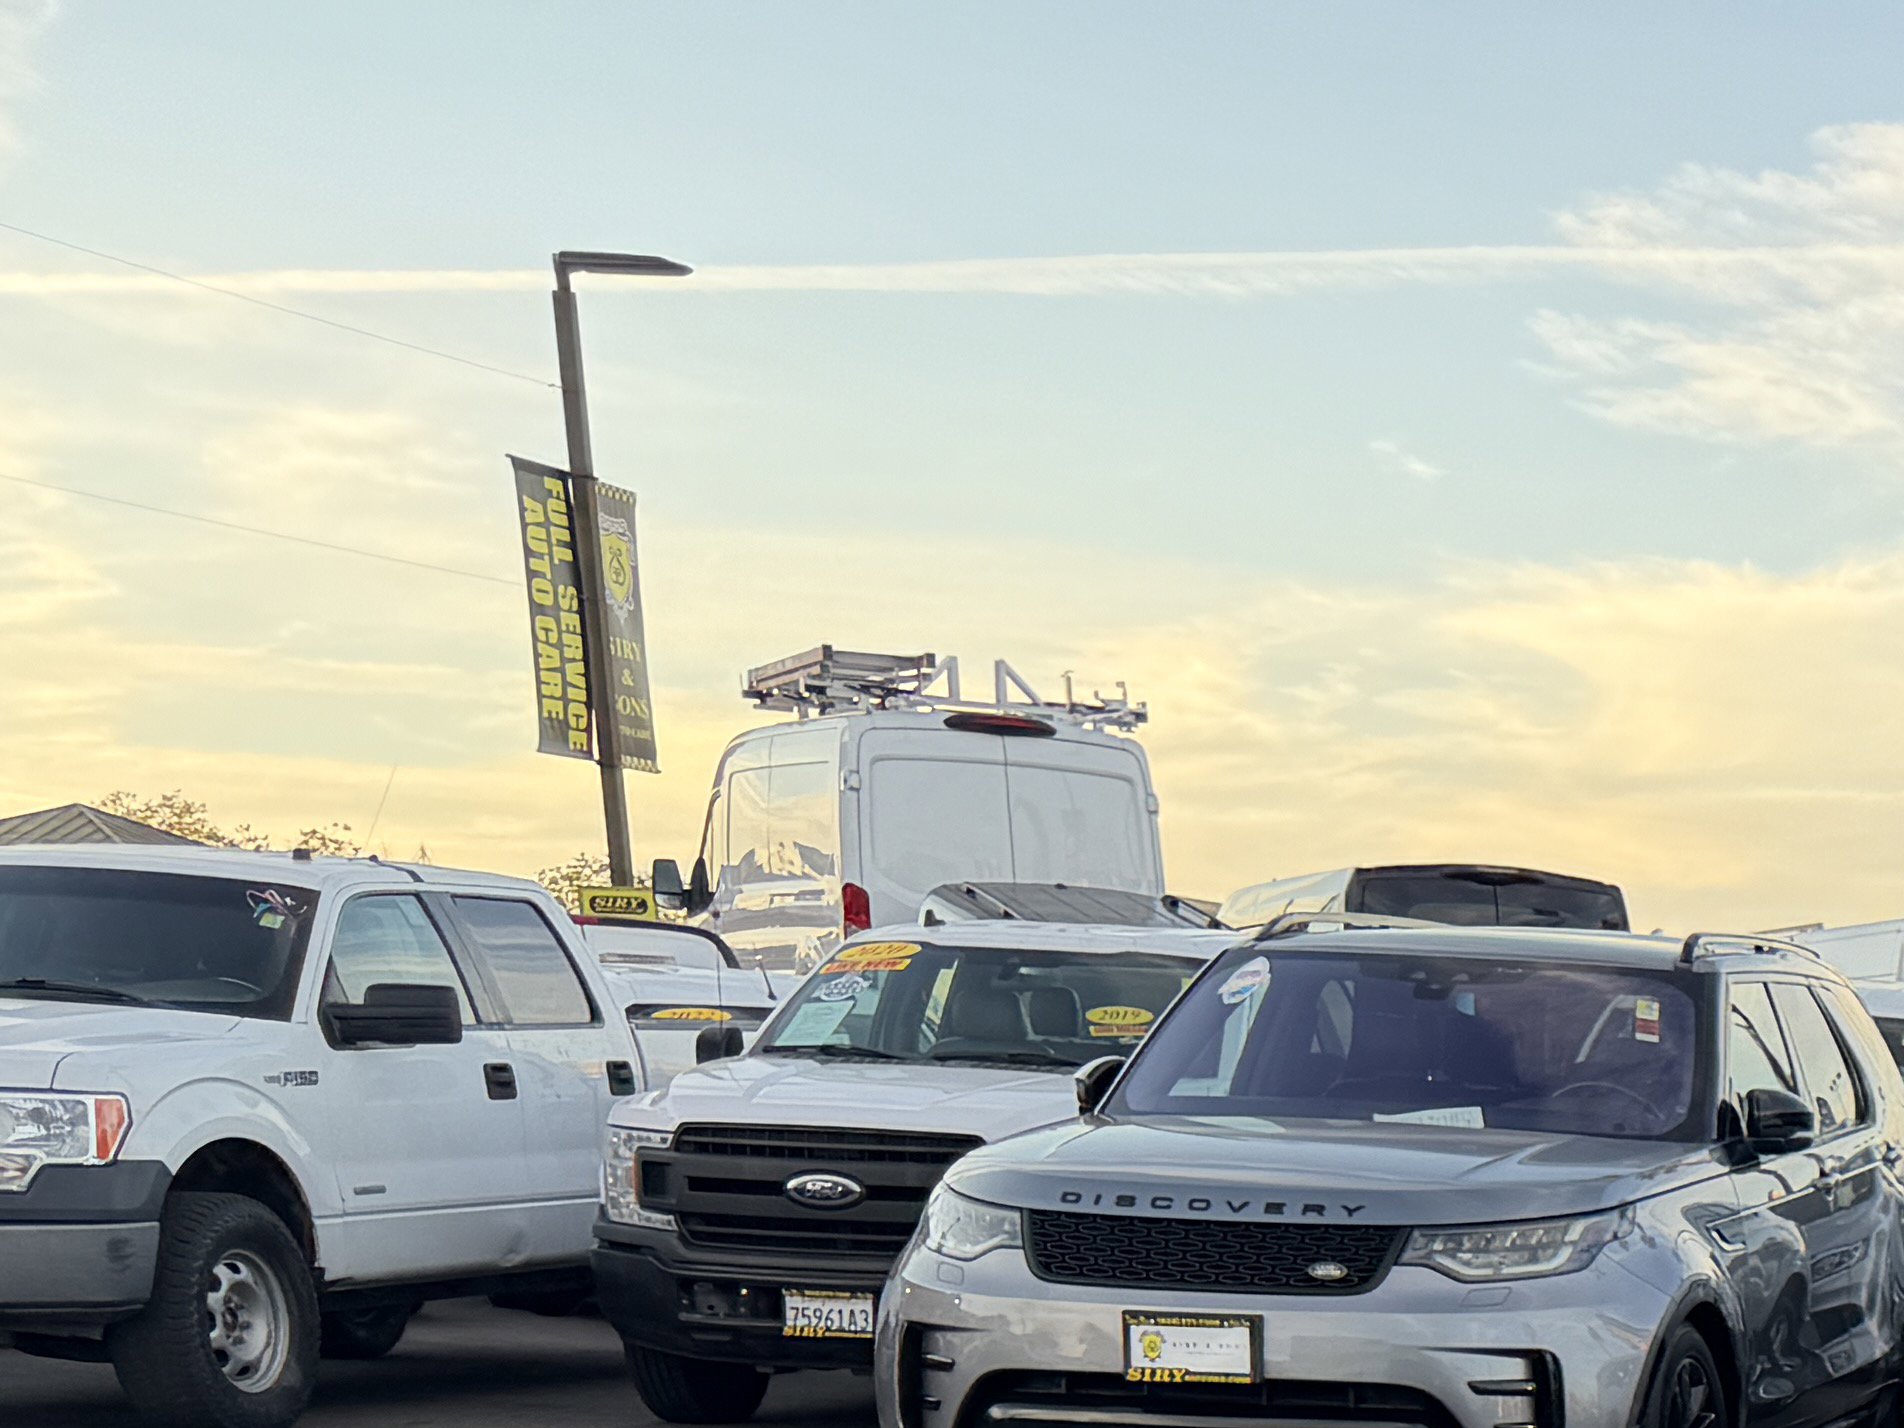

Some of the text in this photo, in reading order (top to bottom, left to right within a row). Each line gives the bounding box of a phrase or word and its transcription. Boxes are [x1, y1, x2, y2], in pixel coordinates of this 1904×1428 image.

[523, 495, 565, 721] AUTO CARE
[544, 476, 589, 751] FULL SERVICE
[621, 668, 634, 687] &
[615, 693, 650, 719] ONS
[1060, 1191, 1367, 1217] DISCOVERY
[789, 1305, 870, 1332] 75961A3
[1126, 1367, 1186, 1383] SIRY
